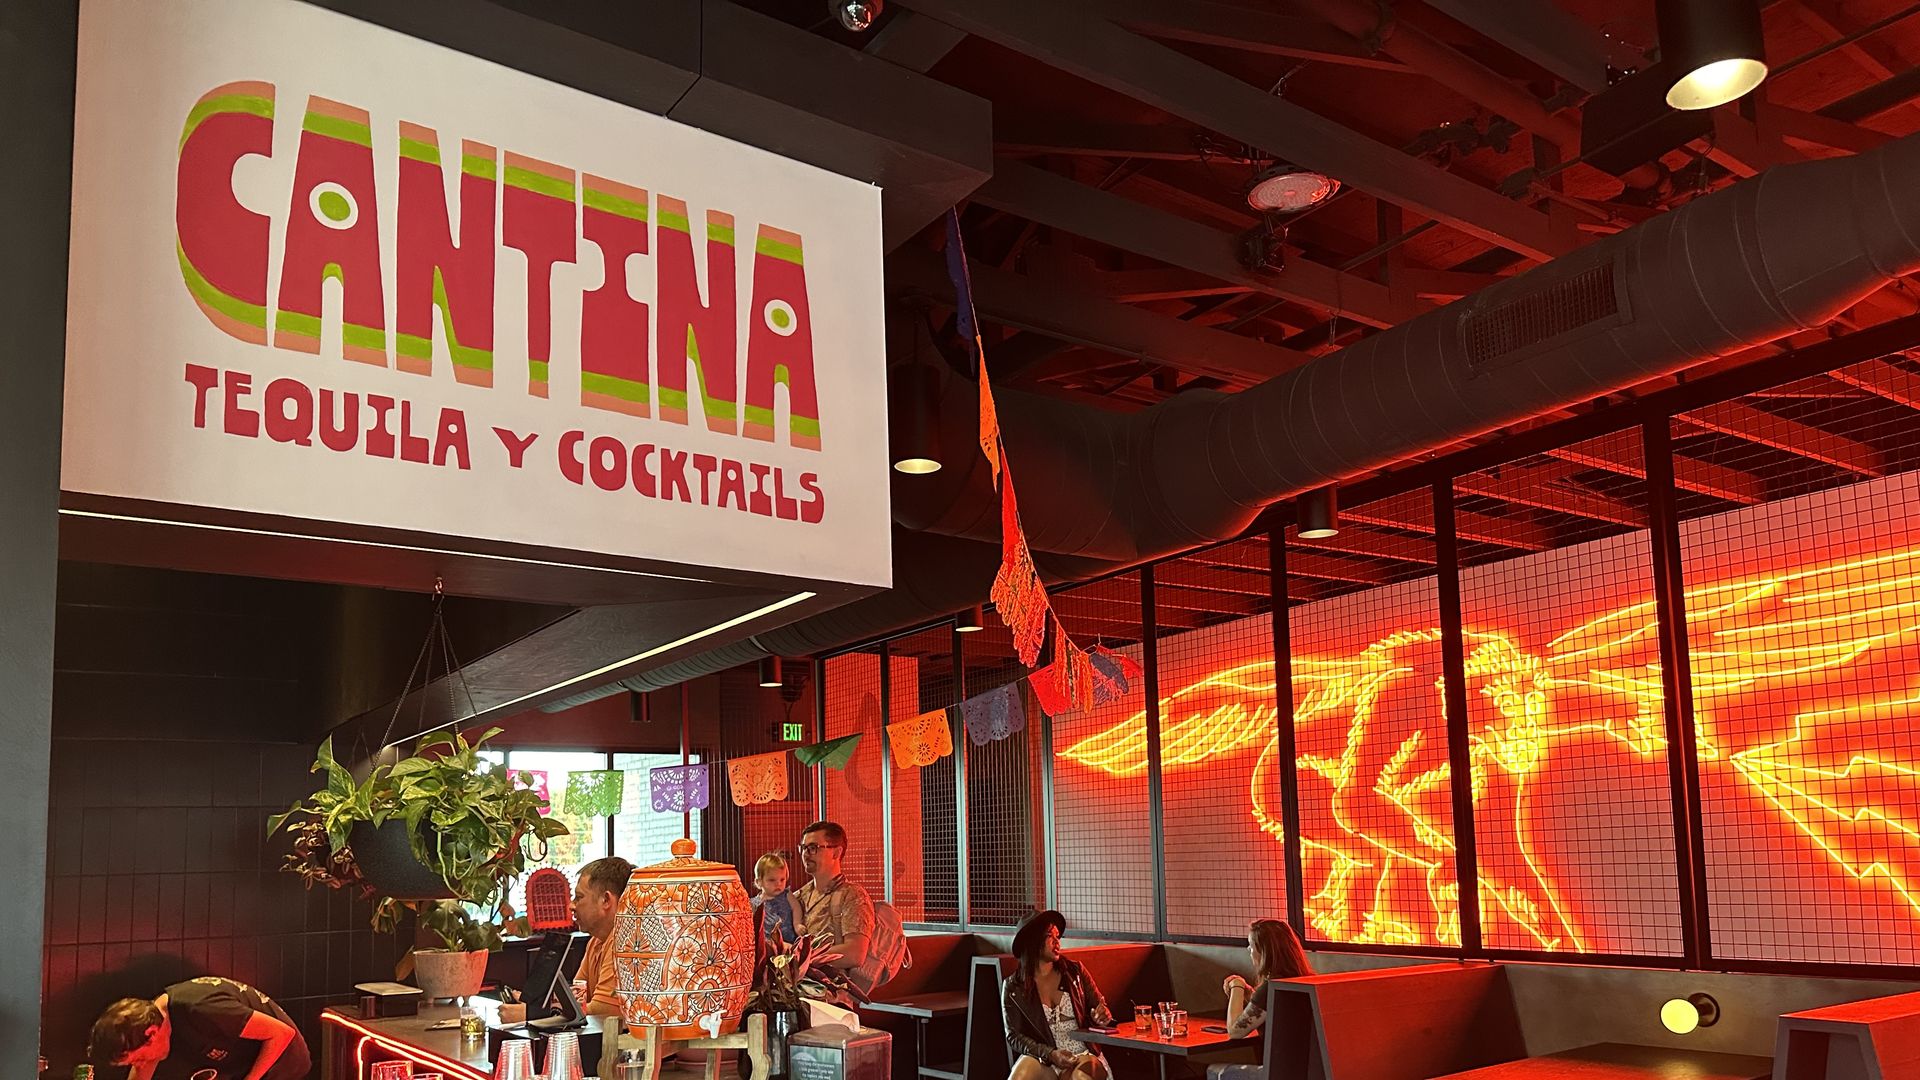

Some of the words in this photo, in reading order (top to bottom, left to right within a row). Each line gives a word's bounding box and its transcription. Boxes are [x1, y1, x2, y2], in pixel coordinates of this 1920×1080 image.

[176, 80, 822, 452] CANTINA
[184, 362, 471, 470] TEQUILA
[491, 426, 539, 469] Y
[558, 430, 825, 524] COCKTAILS
[783, 723, 803, 741] EXIT
